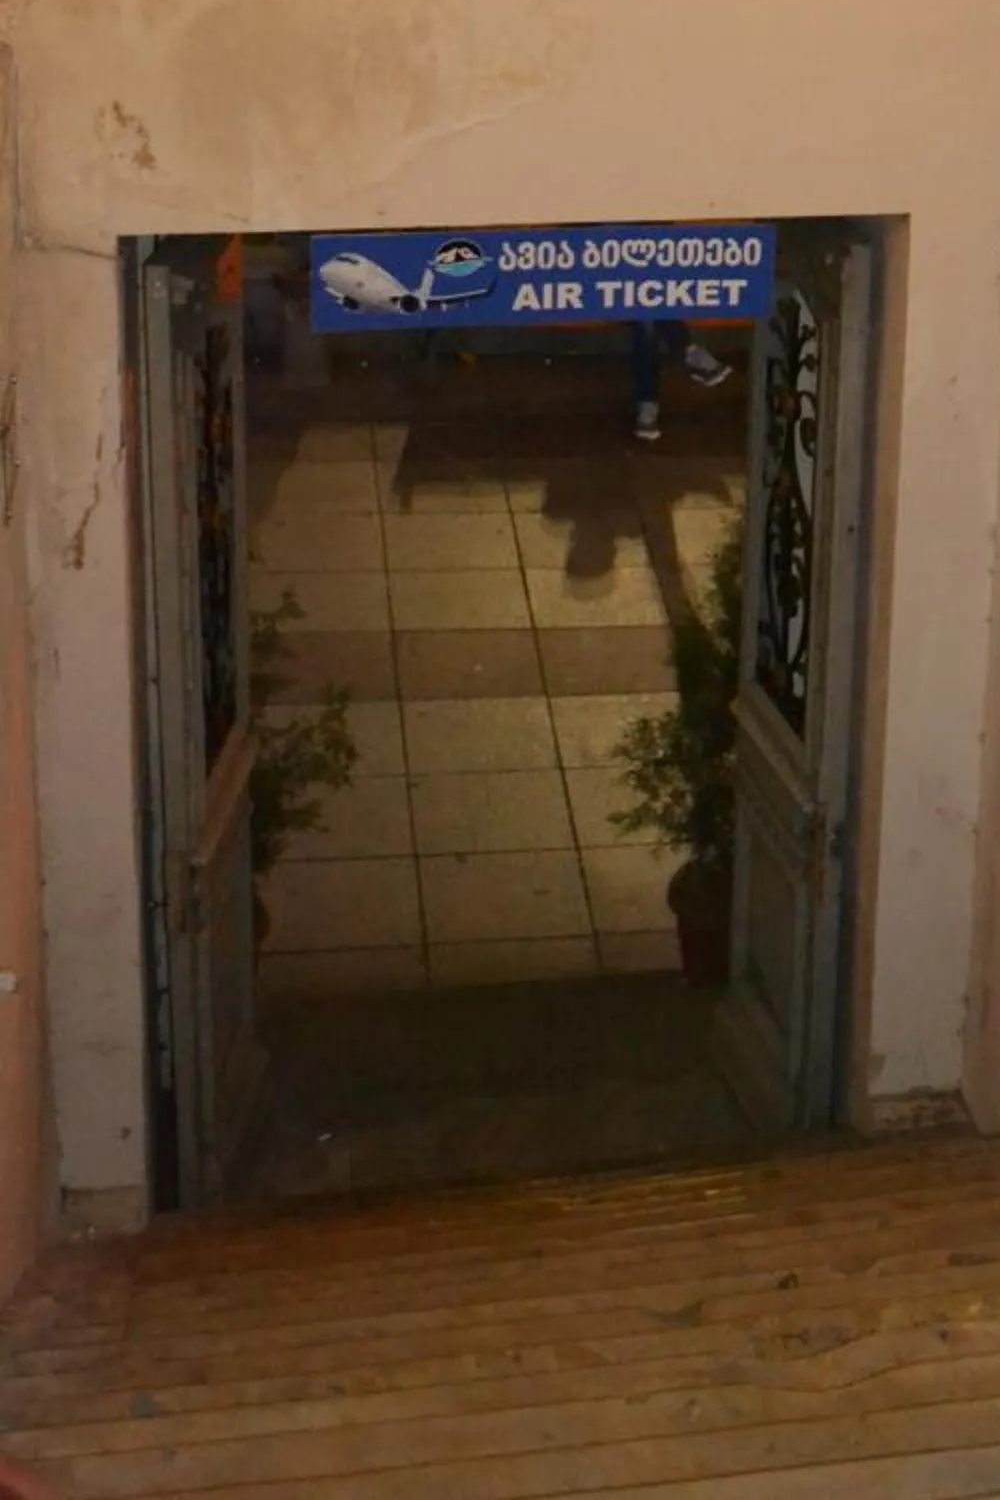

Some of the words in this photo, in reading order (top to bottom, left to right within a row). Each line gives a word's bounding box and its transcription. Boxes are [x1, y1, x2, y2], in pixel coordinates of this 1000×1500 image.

[499, 240, 575, 271] ავია
[583, 237, 762, 268] ბილეთები
[512, 281, 584, 311] AIR
[596, 279, 748, 308] TICKET
